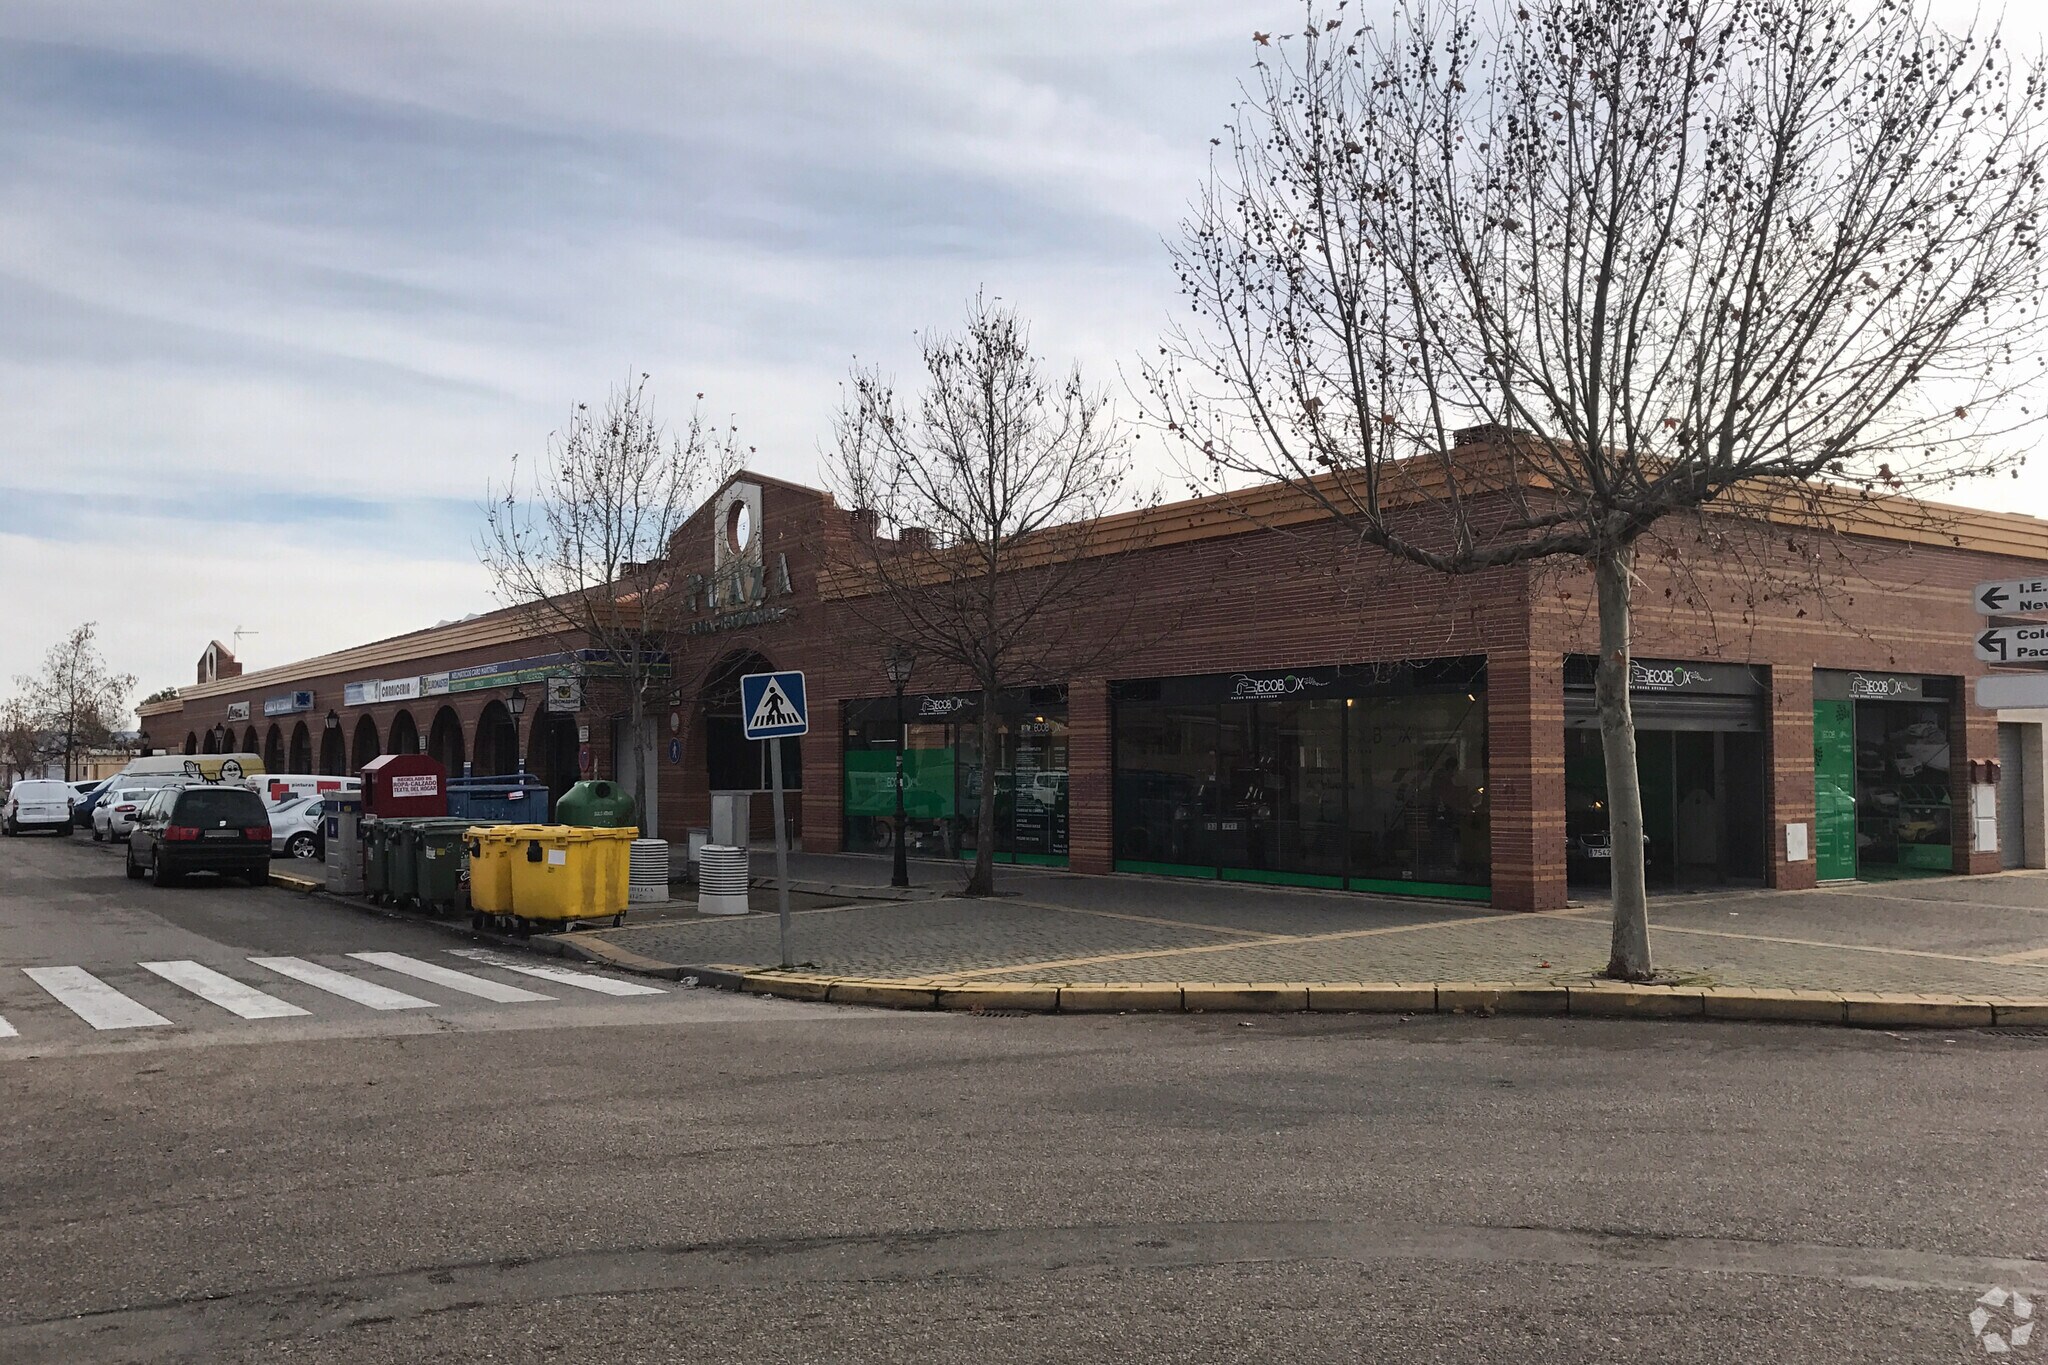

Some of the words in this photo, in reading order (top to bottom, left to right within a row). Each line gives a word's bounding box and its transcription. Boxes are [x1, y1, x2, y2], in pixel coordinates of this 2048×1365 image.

[2017, 629, 2048, 640] Col
[2017, 647, 2048, 658] Pac
[1257, 675, 1304, 693] ECOBOX
[1648, 667, 1691, 687] ECOBOX
[1868, 678, 1902, 695] ECOBOX
[934, 696, 963, 711] ECOBOX
[393, 780, 437, 788] ROPA-CALZADO
